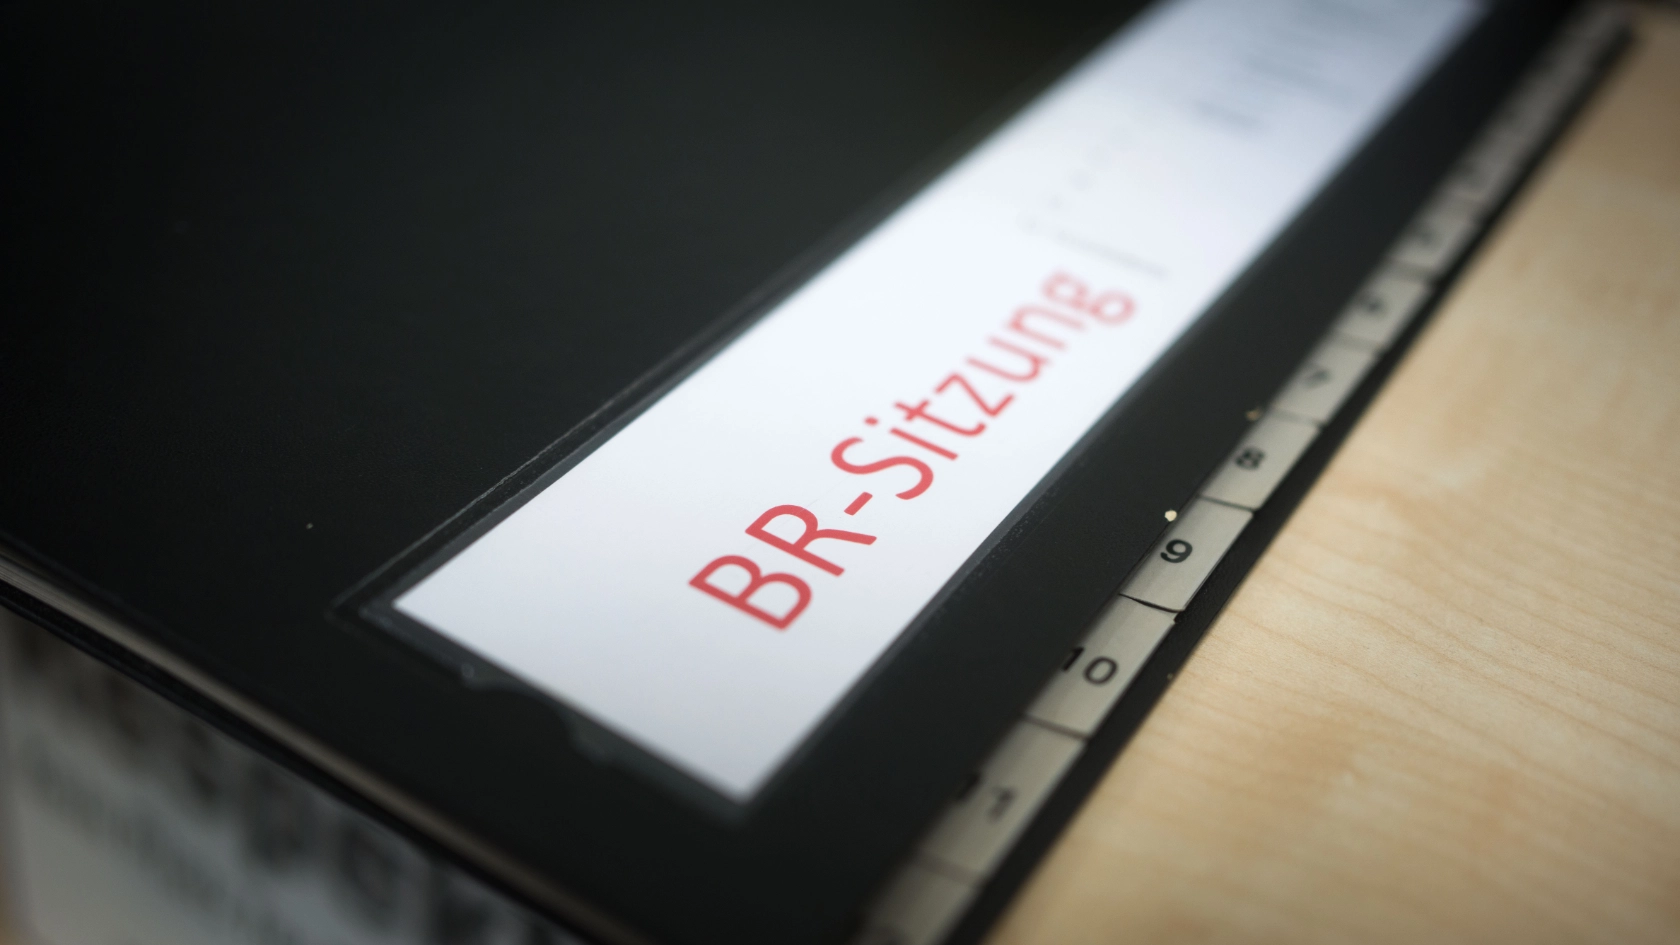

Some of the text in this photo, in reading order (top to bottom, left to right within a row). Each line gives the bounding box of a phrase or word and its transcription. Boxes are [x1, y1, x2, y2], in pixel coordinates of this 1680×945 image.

[689, 271, 1136, 630] BR-Sitzung
[1234, 446, 1266, 470] 8
[1159, 539, 1193, 563] 9
[1062, 647, 1118, 686] 10
